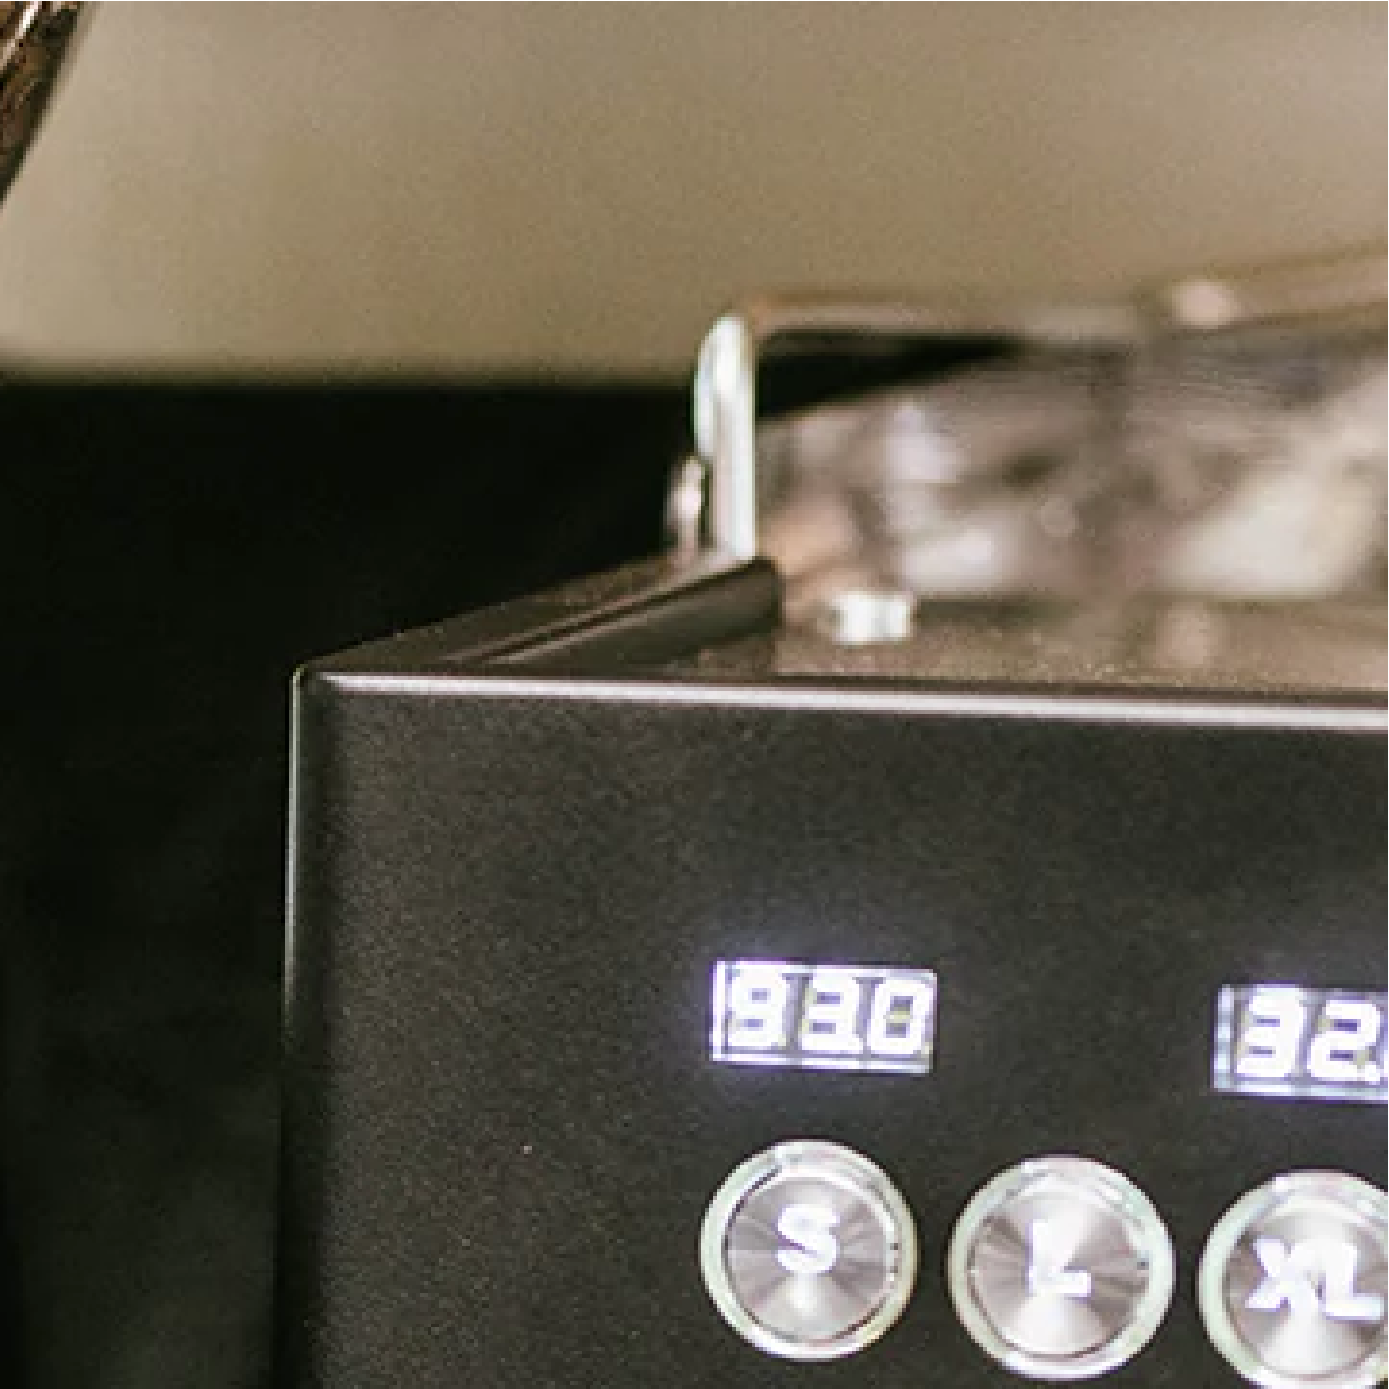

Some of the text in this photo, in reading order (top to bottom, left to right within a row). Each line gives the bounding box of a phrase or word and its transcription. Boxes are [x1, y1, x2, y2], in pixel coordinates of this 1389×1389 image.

[777, 1203, 839, 1274] S
[1026, 1218, 1091, 1298] L
[1244, 1236, 1385, 1320] XL
